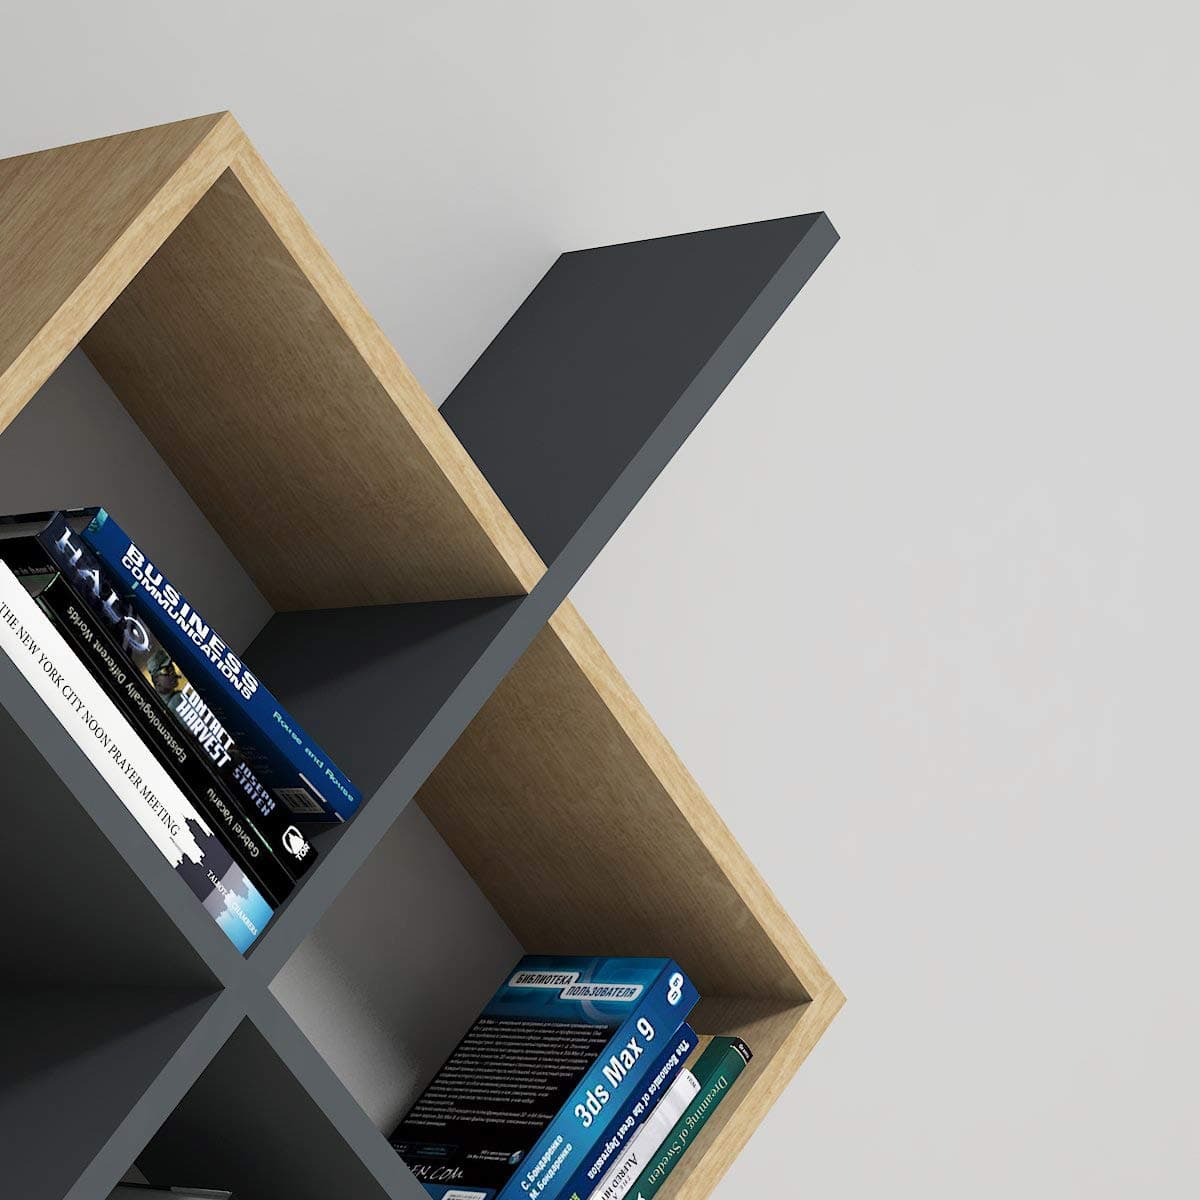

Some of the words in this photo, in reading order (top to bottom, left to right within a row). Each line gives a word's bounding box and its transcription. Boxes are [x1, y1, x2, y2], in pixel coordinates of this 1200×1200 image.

[56, 527, 150, 651] HALO
[67, 606, 93, 642] Worlds
[122, 555, 253, 700] COMMUNICATIONS
[126, 543, 259, 693] BUSINESS
[93, 639, 126, 685] Different
[16, 626, 40, 655] NEW
[37, 652, 65, 688] YORK
[62, 685, 85, 713] CITY
[81, 710, 112, 748] NOON
[107, 744, 142, 789] PRAYER
[139, 785, 180, 836] MEETING
[125, 680, 186, 763] Epistemologically
[176, 694, 231, 767] HARVEST
[182, 682, 235, 750] CONTACT
[273, 711, 302, 745] Rouse
[305, 747, 324, 769] and
[325, 768, 354, 802] Rouse
[206, 787, 233, 826] Vacariu
[232, 768, 270, 816] STATEN
[239, 762, 275, 810] JOSEPH
[232, 823, 259, 857] Gabriel
[515, 974, 574, 985] БИБЛИОТЕКА
[567, 985, 637, 998] ПОЛЬЗОВАТЕЛЯ
[676, 1039, 690, 1056] The
[574, 1084, 610, 1129] 3ds
[602, 1037, 644, 1089] Max
[636, 1017, 655, 1042] 9
[648, 1052, 679, 1095] Economics
[633, 1103, 645, 1117] the
[642, 1093, 650, 1107] of
[686, 1075, 728, 1130] Dreaming
[618, 1115, 635, 1140] Great
[679, 1129, 689, 1146] of
[528, 1135, 564, 1182] Бондаренко
[537, 1143, 573, 1191] Бондаренко
[587, 1136, 620, 1180] Depression
[613, 1153, 638, 1188] ALFRED
[648, 1142, 681, 1184] Sweden
